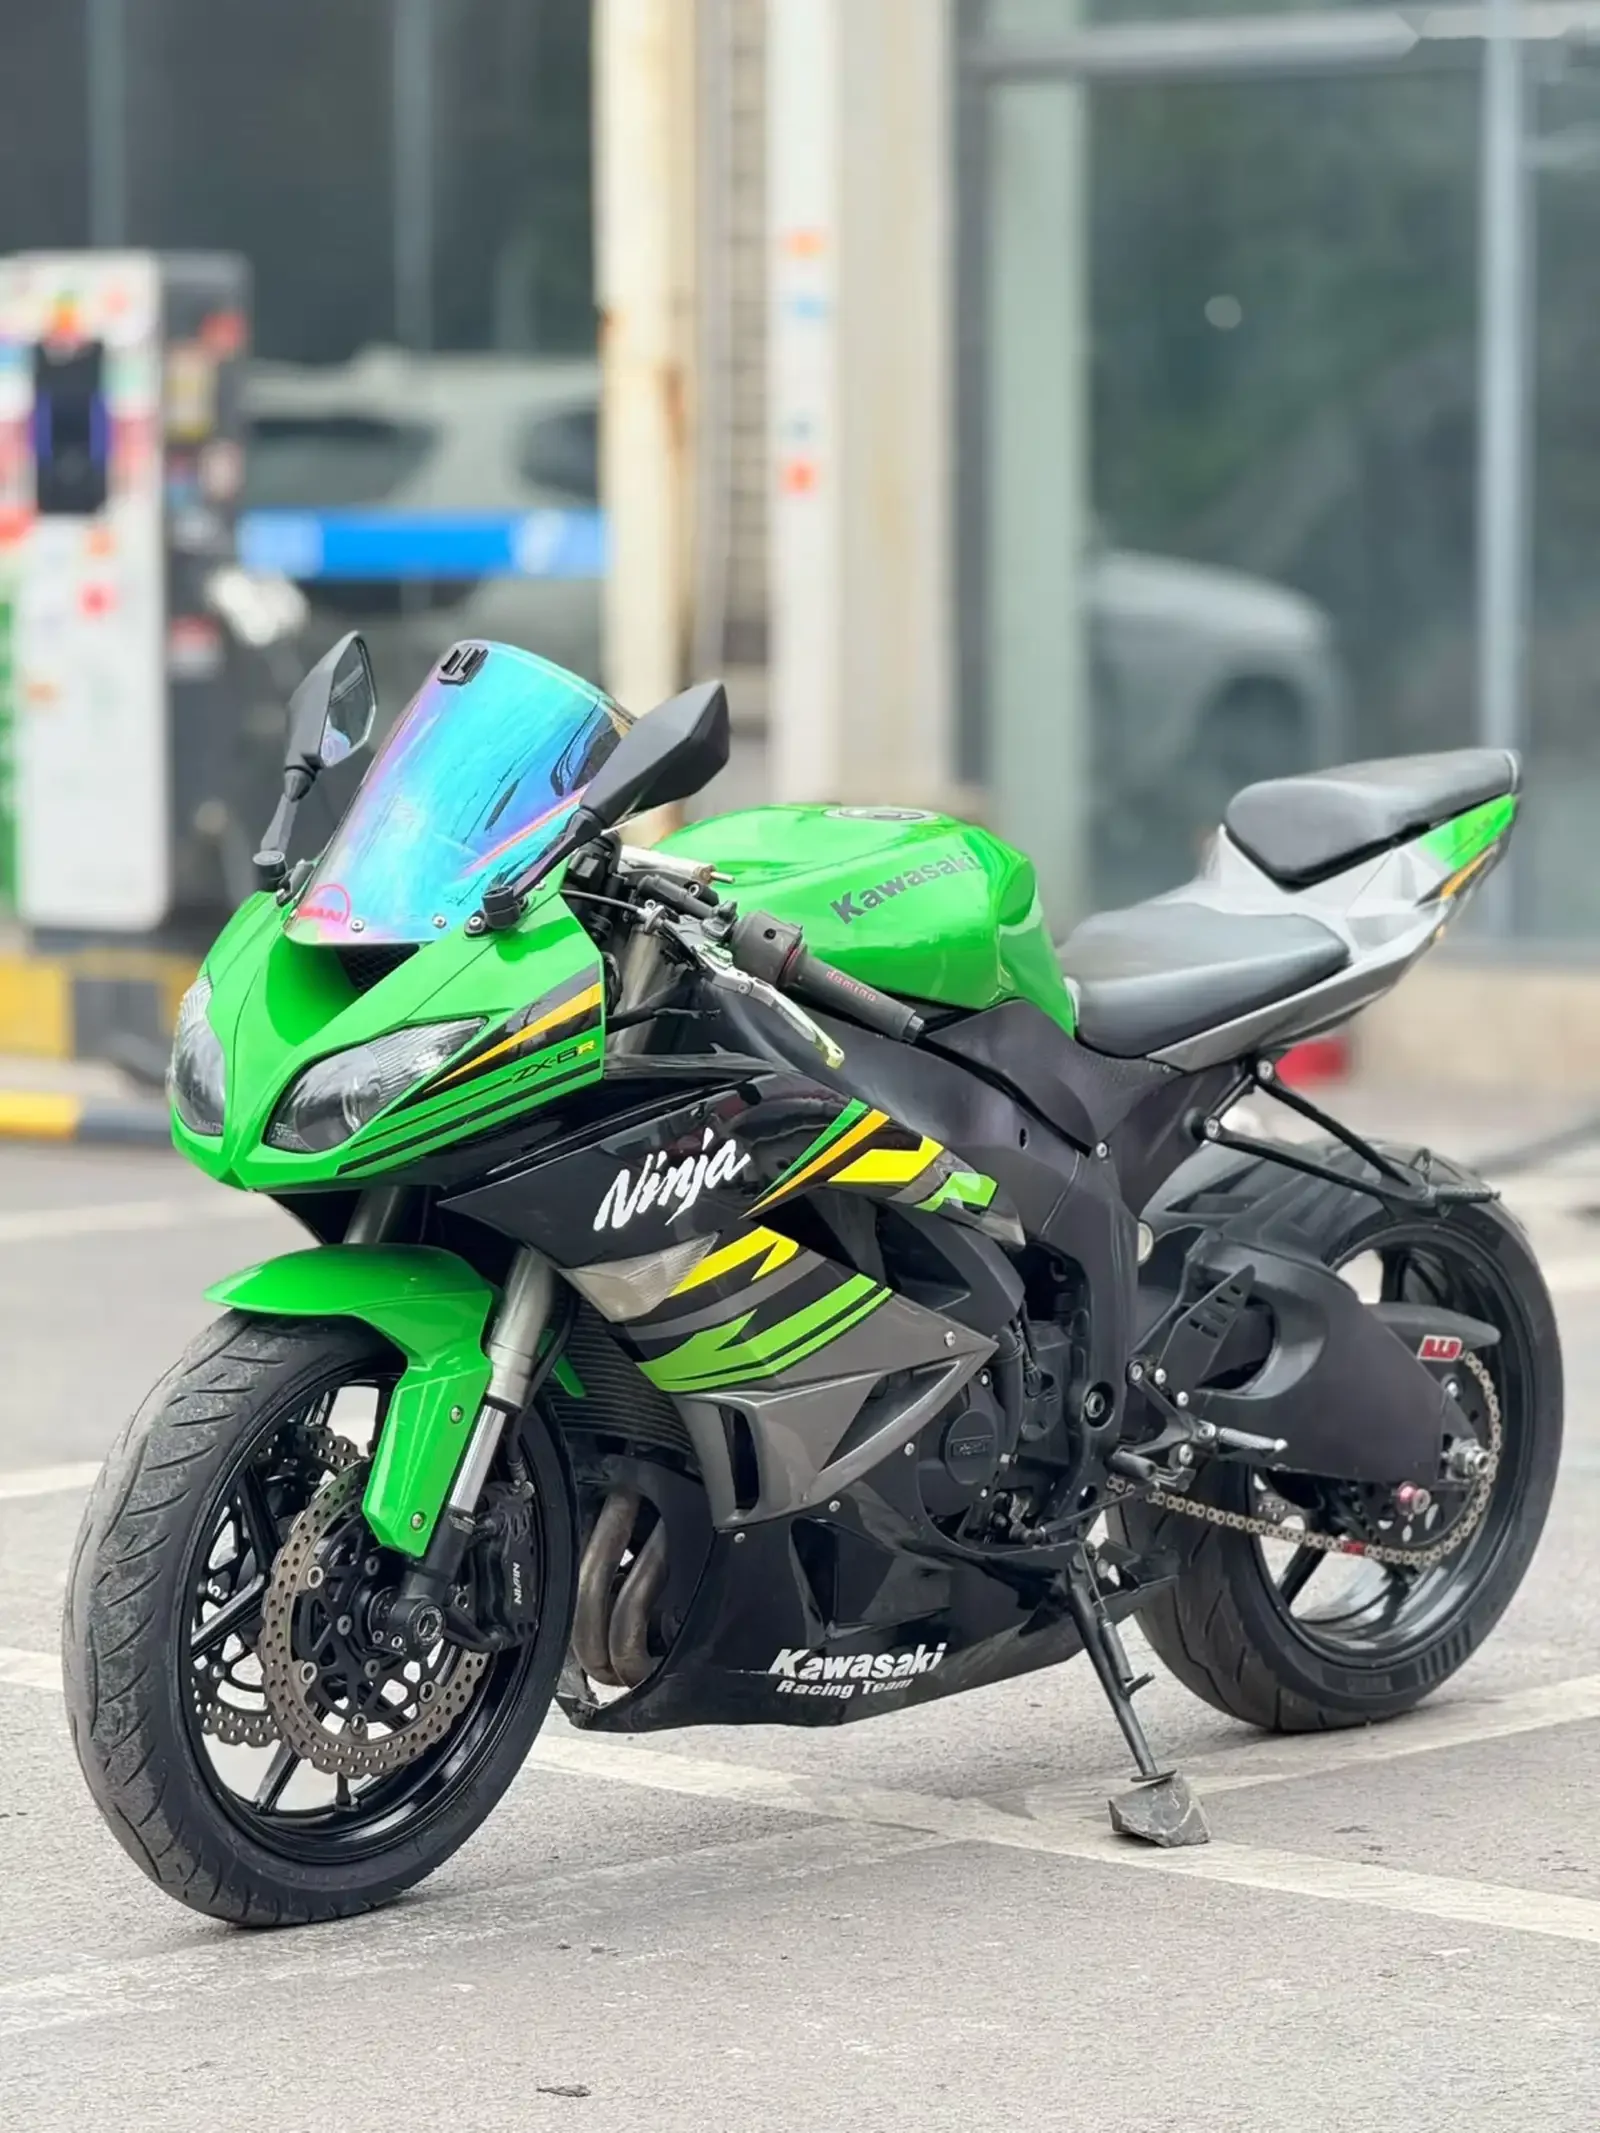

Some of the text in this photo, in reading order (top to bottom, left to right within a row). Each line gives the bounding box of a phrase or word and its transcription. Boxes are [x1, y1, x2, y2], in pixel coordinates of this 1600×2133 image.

[829, 851, 984, 925] Kawasaki
[511, 1039, 596, 1084] ZX-6R
[592, 1127, 752, 1231] Ninja
[768, 1642, 948, 1680] Kawasaki
[776, 1678, 914, 1698] Racing Team
